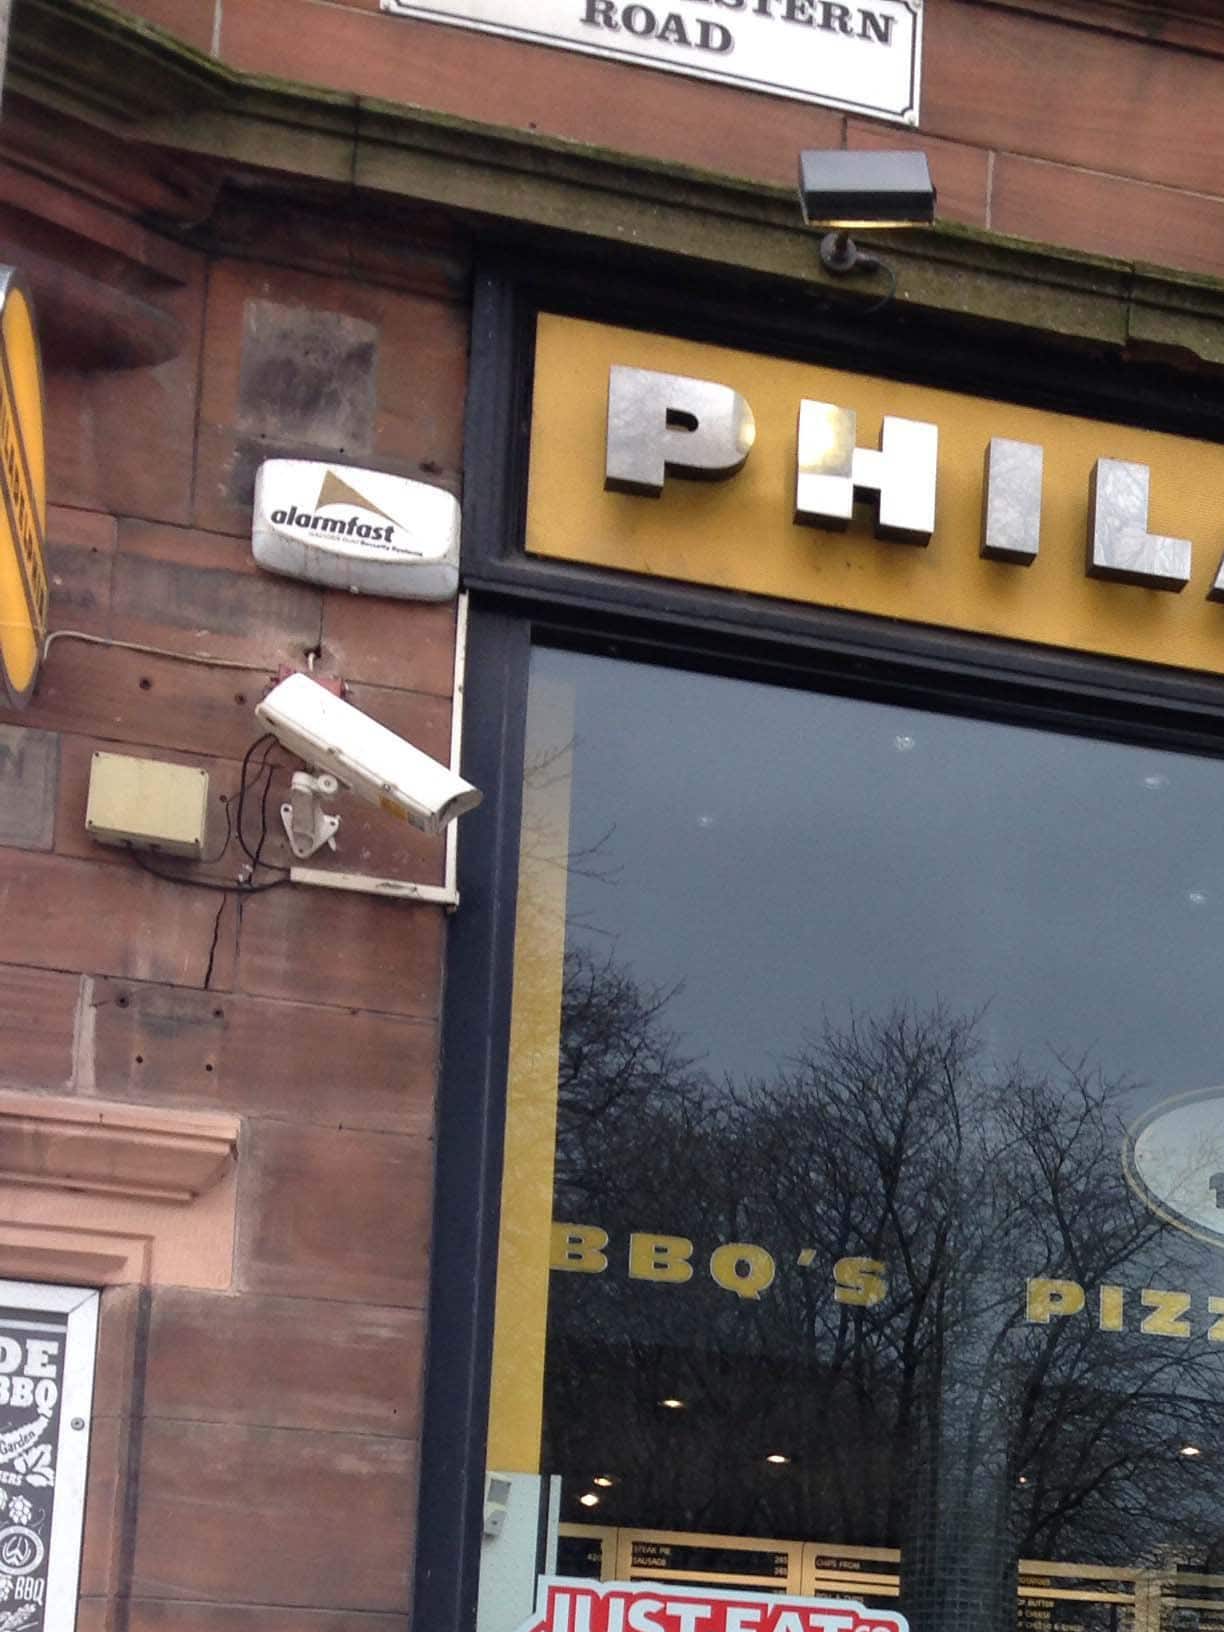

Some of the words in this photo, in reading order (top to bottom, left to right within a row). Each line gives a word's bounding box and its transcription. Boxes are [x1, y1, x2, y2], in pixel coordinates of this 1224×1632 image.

[580, 0, 734, 54] ROAD
[686, 0, 898, 46] TERN
[271, 505, 395, 543] alarmfast
[549, 1221, 888, 1307] BBQ'S
[14, 1576, 45, 1606] BBQ
